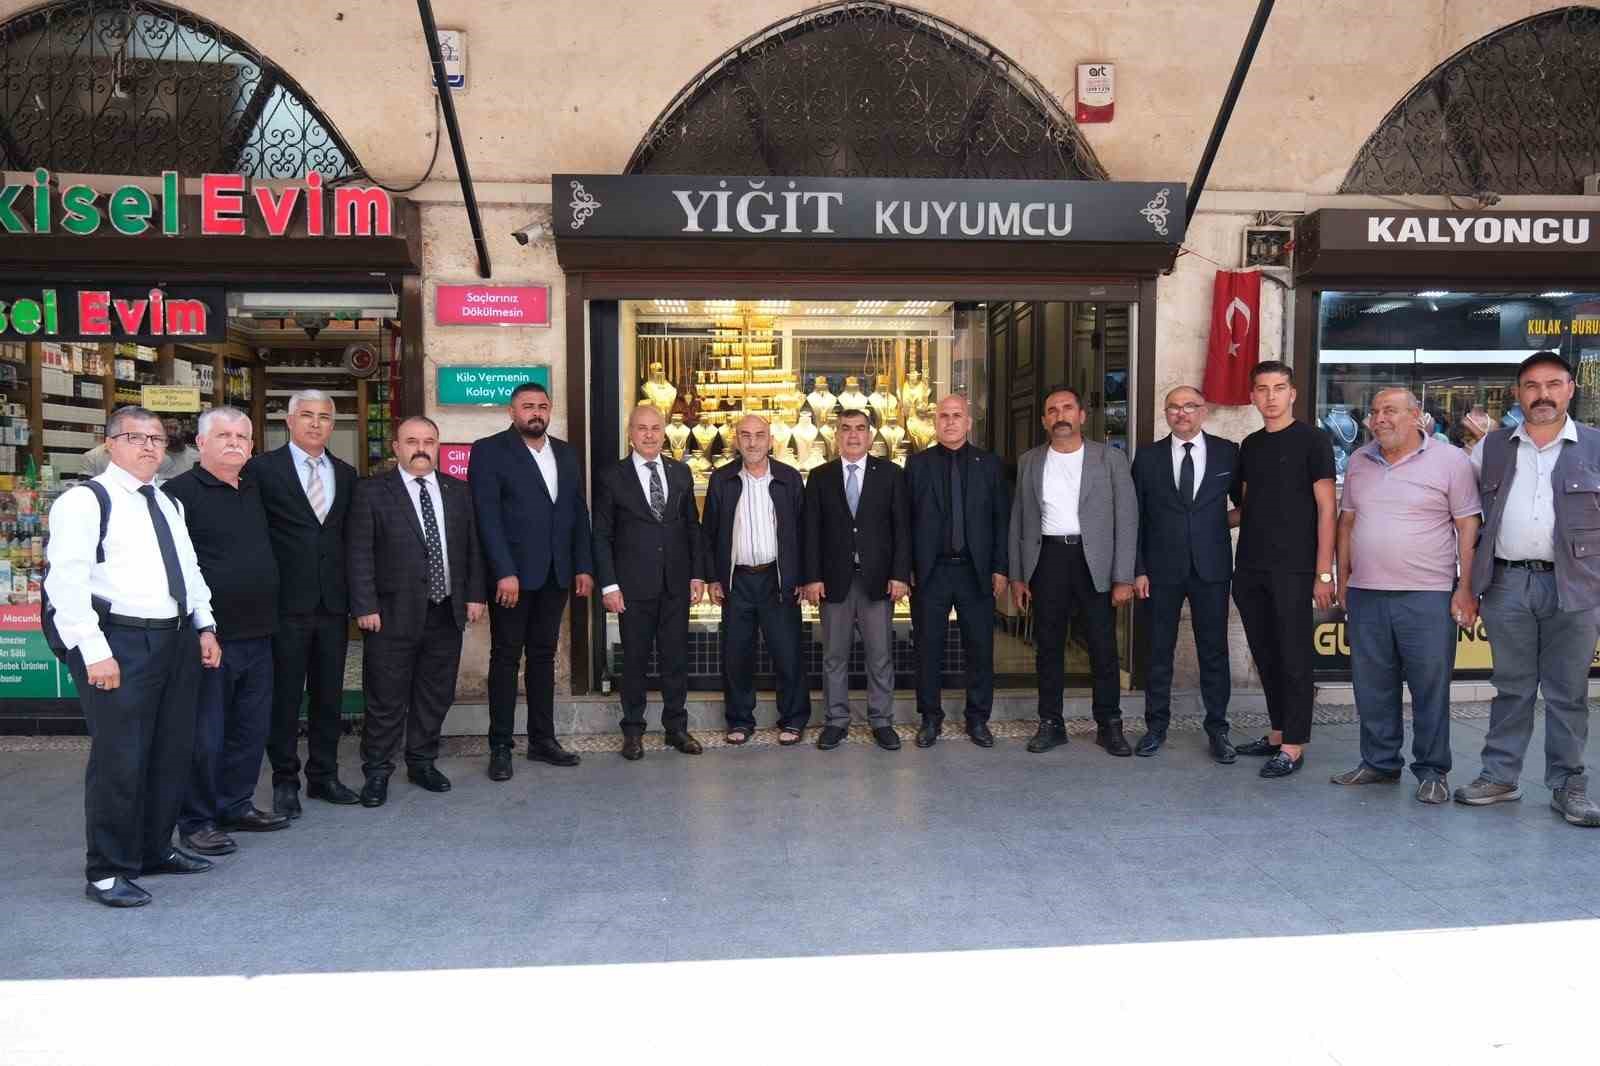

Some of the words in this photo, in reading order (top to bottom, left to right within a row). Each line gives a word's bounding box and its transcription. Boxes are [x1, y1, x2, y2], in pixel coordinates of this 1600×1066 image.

[201, 171, 393, 236] Evim
[671, 179, 843, 233] YİĞİT
[875, 200, 1073, 237] KUYUMCU
[1367, 216, 1590, 243] KALYONCU
[466, 292, 519, 304] Saçlarınız
[78, 289, 207, 336] Evim
[462, 306, 524, 317] Dökülmesin
[1527, 319, 1561, 335] KULAK
[456, 372, 476, 382] Kilo
[479, 372, 530, 382] Vermenin
[466, 386, 496, 399] Kolay
